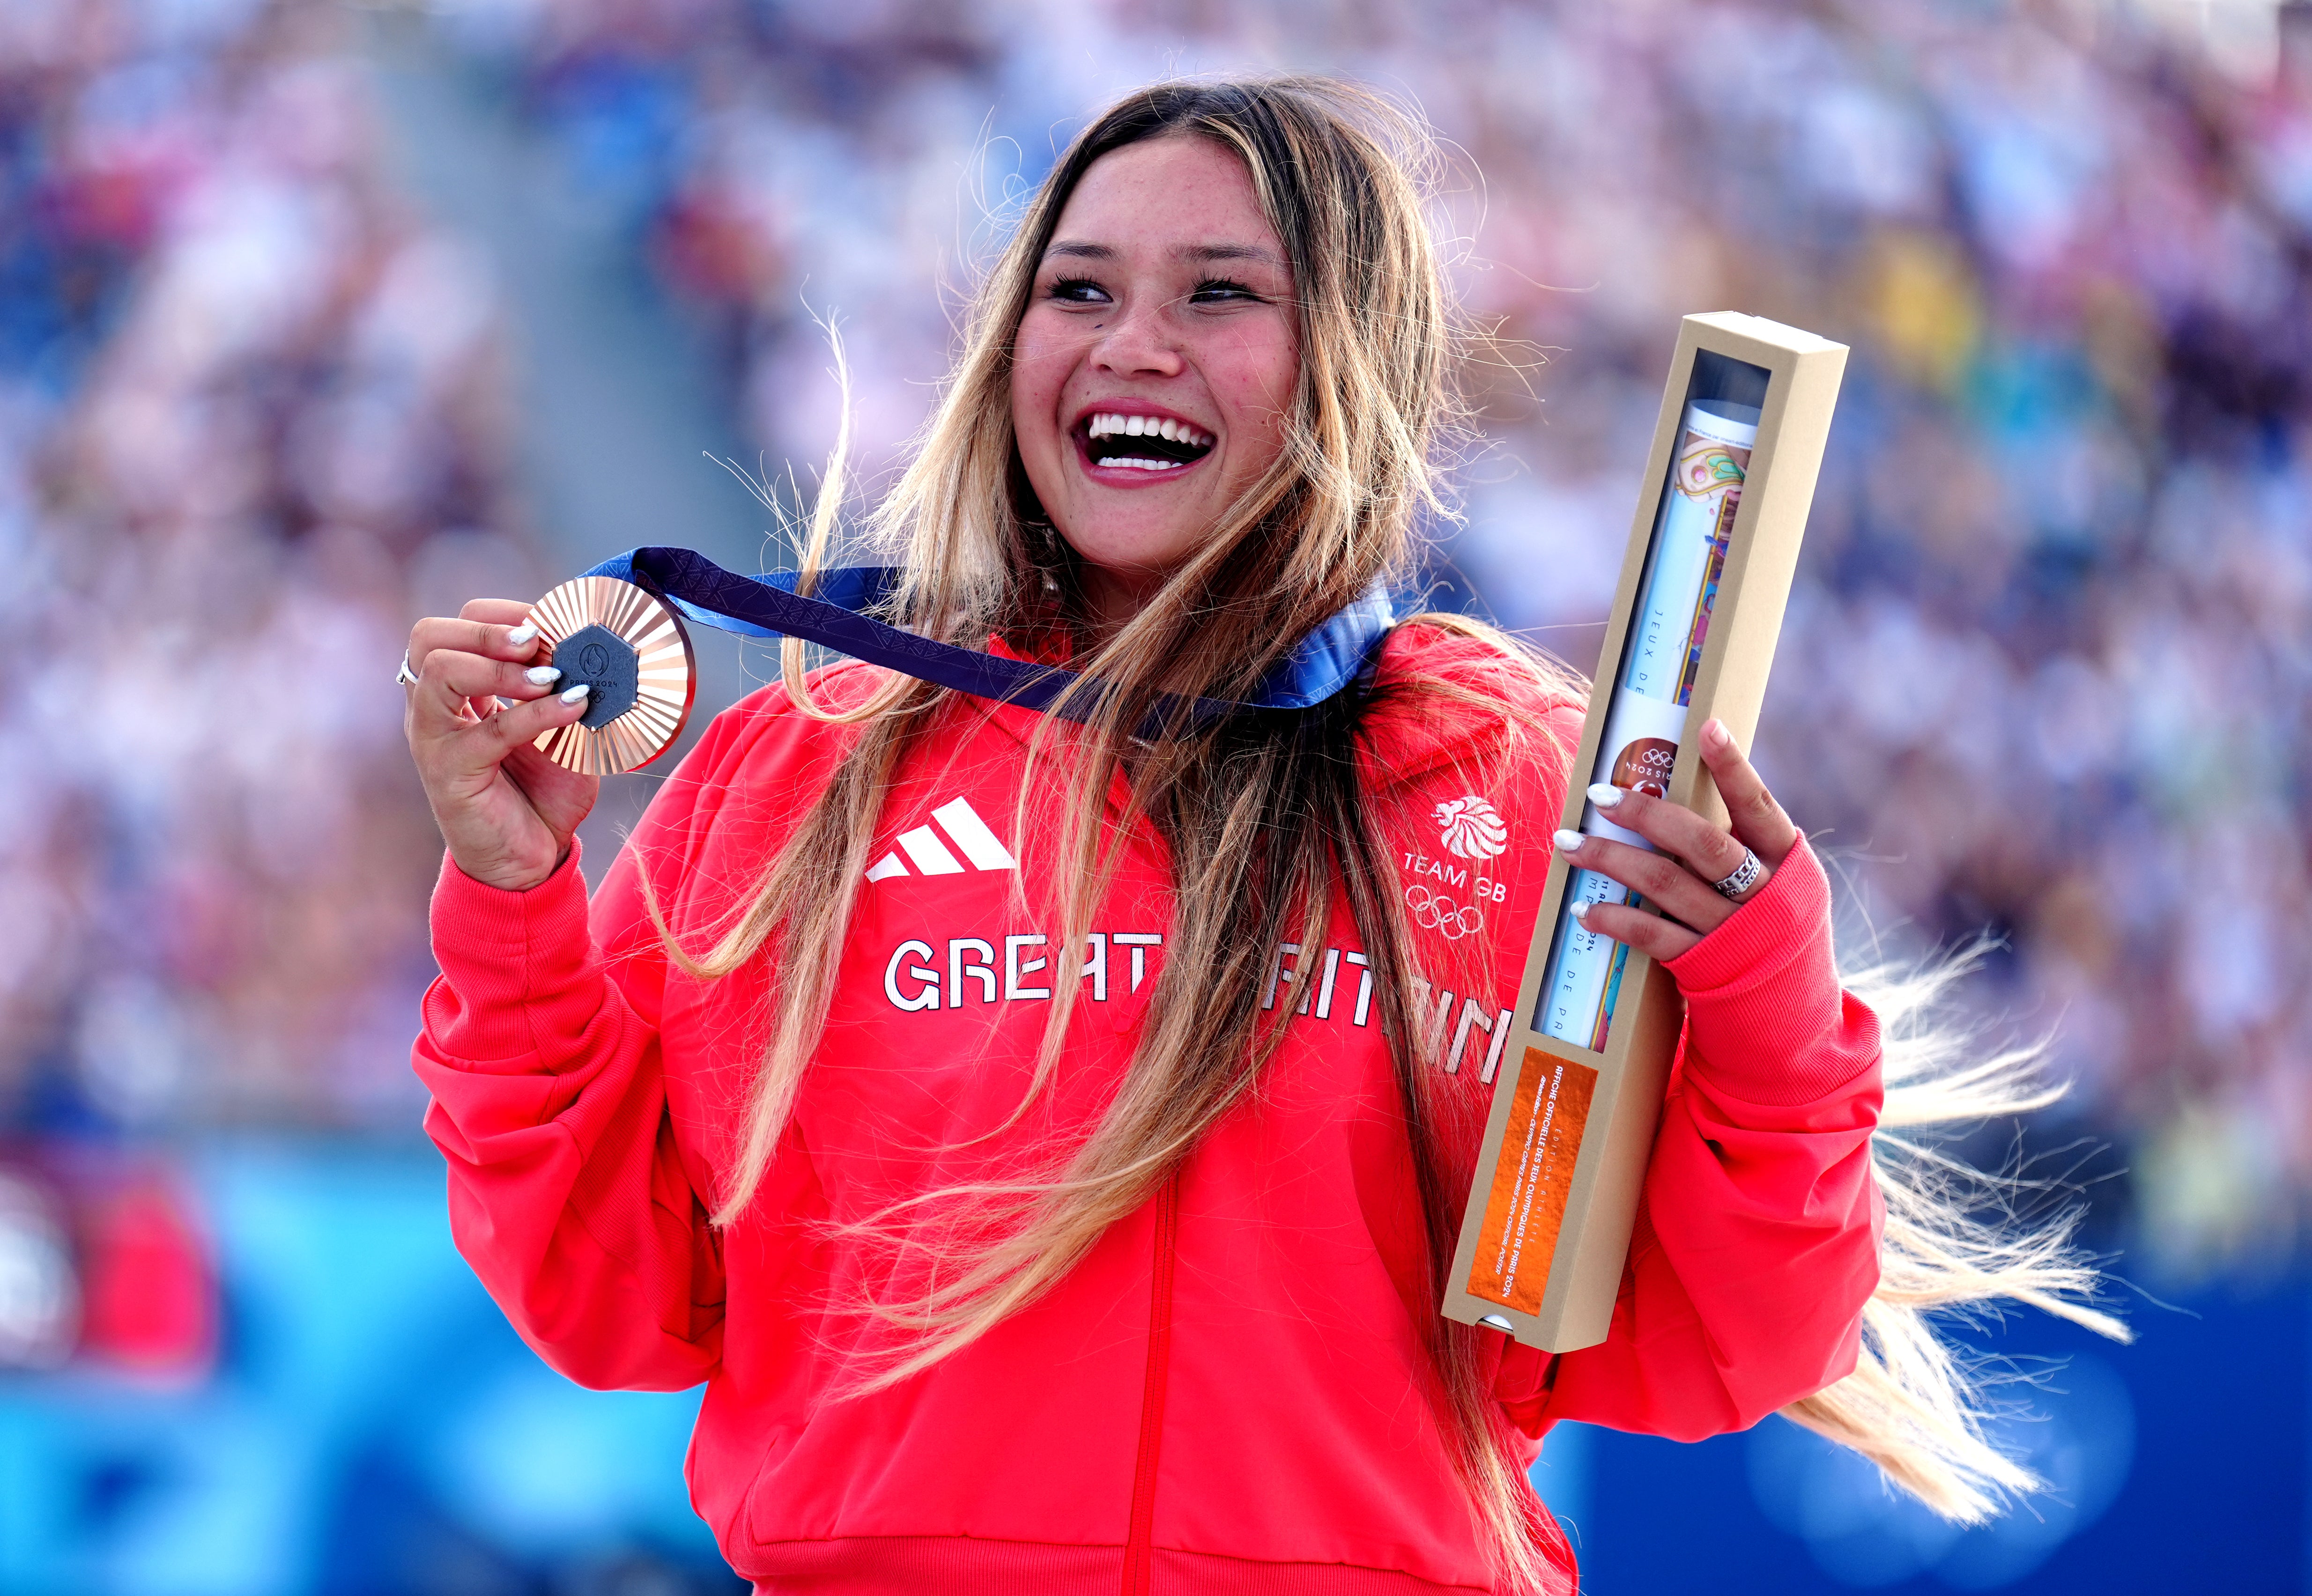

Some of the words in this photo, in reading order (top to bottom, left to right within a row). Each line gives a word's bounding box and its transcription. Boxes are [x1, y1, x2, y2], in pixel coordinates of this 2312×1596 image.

[1645, 610, 1663, 658] JEUX
[1635, 672, 1648, 695] DE
[1626, 761, 1652, 776] 2024
[1404, 852, 1467, 888] TEAM
[1476, 877, 1507, 903] GB
[1563, 970, 1576, 993] DE
[1549, 1065, 1563, 1101] AFFICHE
[1525, 1119, 1536, 1151] OLYMPIC
[1538, 1101, 1554, 1147] OFFICIELLE
[1534, 1147, 1543, 1163] DES
[1529, 1164, 1540, 1183] JEUX
[1514, 1175, 1523, 1197] PARIS
[1517, 1184, 1534, 1237] OLYMPIQUES
[1502, 1216, 1512, 1247] OFFICIAL
[1514, 1238, 1522, 1249] DE
[1496, 1247, 1505, 1275] POSTER
[1508, 1250, 1519, 1274] PARIS
[1503, 1275, 1513, 1297] 2024
